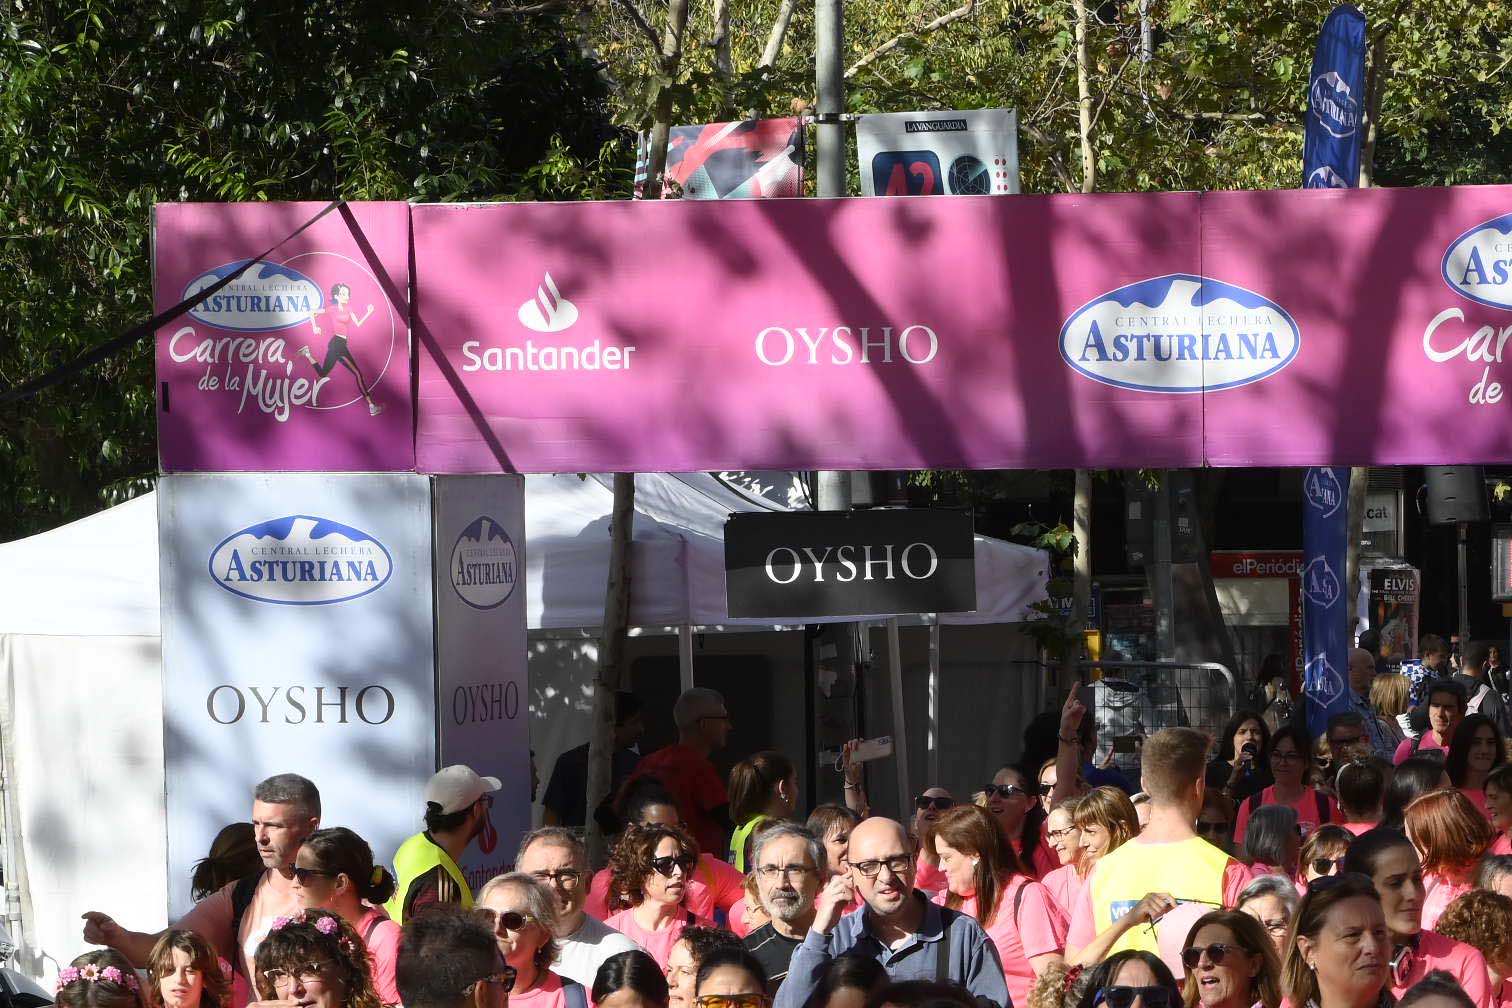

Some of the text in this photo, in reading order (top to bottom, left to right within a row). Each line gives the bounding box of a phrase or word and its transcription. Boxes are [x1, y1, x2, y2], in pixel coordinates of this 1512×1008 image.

[192, 286, 311, 313] ASTURIANA
[1114, 315, 1189, 328] CENTRAL
[169, 327, 286, 364] Carrera
[462, 340, 635, 373] Santander
[755, 325, 939, 367] OYSHO
[1078, 319, 1281, 362] ASTURIANA
[198, 361, 330, 422] de la Mujer
[1469, 367, 1503, 405] de
[224, 549, 379, 582] ASTURIANA
[251, 547, 309, 556] CENTRAL
[456, 552, 513, 586] ASTURIANA
[765, 542, 938, 584] OYSHO
[1233, 559, 1304, 575] elPeriódi
[1384, 579, 1414, 591] ELVIS
[207, 685, 395, 725] OYSHO
[453, 681, 519, 726] OYSHO
